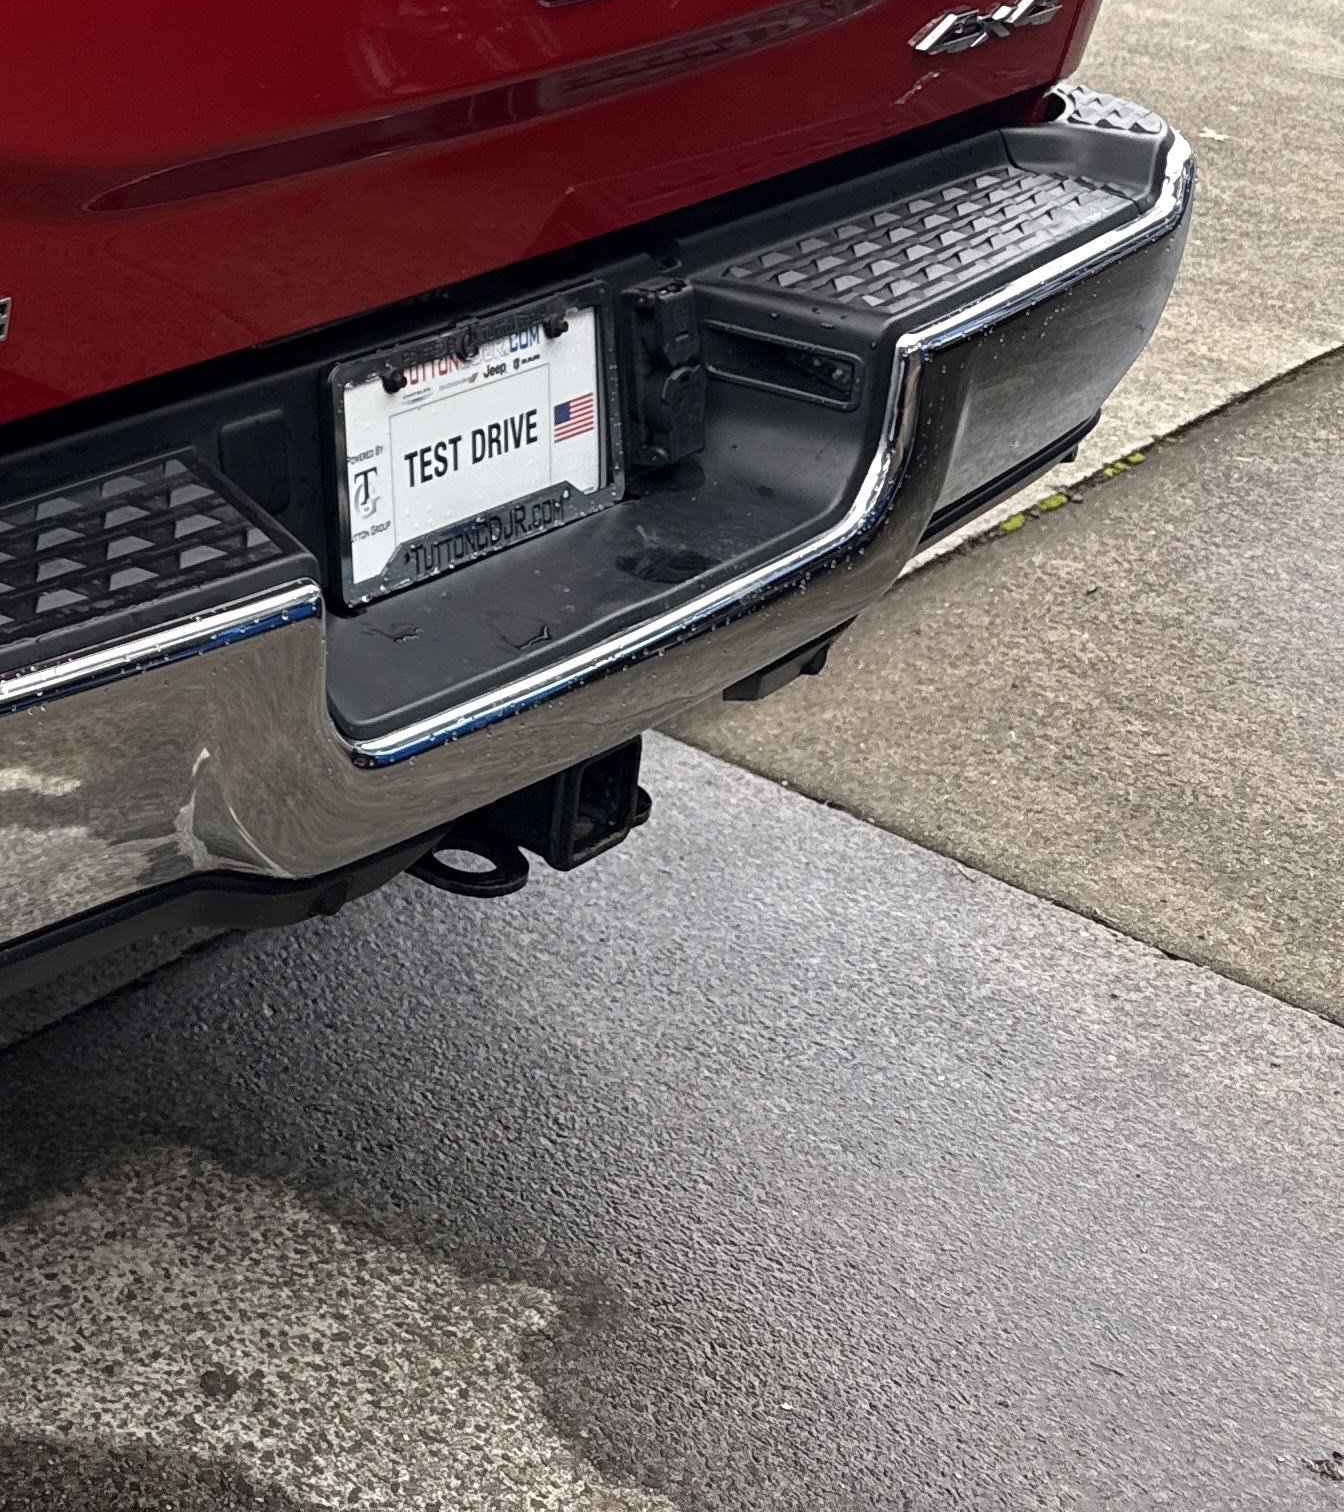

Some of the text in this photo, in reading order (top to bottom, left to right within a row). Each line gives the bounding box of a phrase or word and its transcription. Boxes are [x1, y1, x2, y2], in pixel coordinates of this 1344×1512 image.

[483, 362, 507, 379] Jeep
[404, 409, 538, 487] TEST DRIVE
